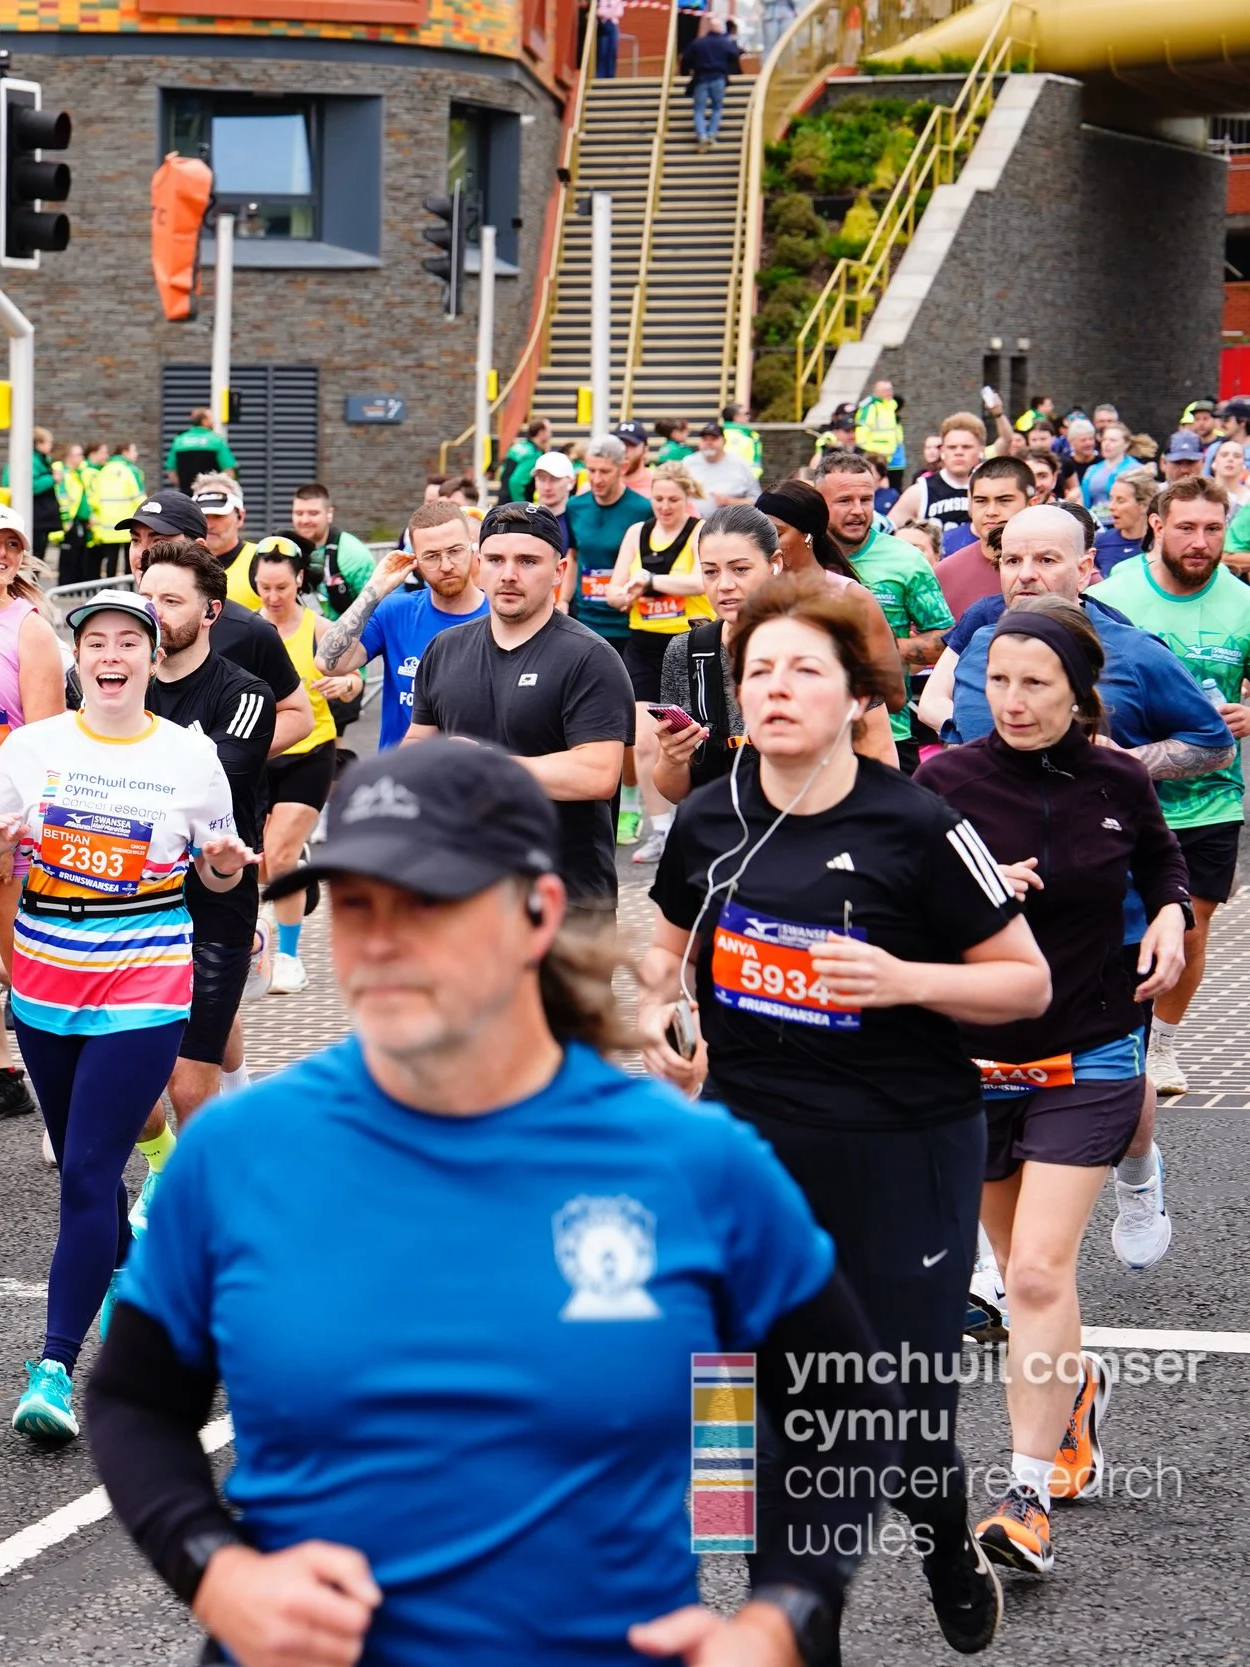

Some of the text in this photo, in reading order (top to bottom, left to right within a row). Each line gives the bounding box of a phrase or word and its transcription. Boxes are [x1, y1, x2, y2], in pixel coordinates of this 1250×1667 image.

[65, 784, 108, 799] cymru
[68, 771, 176, 795] ymchwil canser
[93, 815, 131, 829] SWANSEA
[209, 812, 232, 831] #TE
[43, 828, 90, 846] BETHAN
[59, 843, 124, 877] 2393
[58, 871, 119, 892] #RUNSWANSEA
[717, 935, 758, 959] ANYA
[740, 959, 832, 1005] 5934
